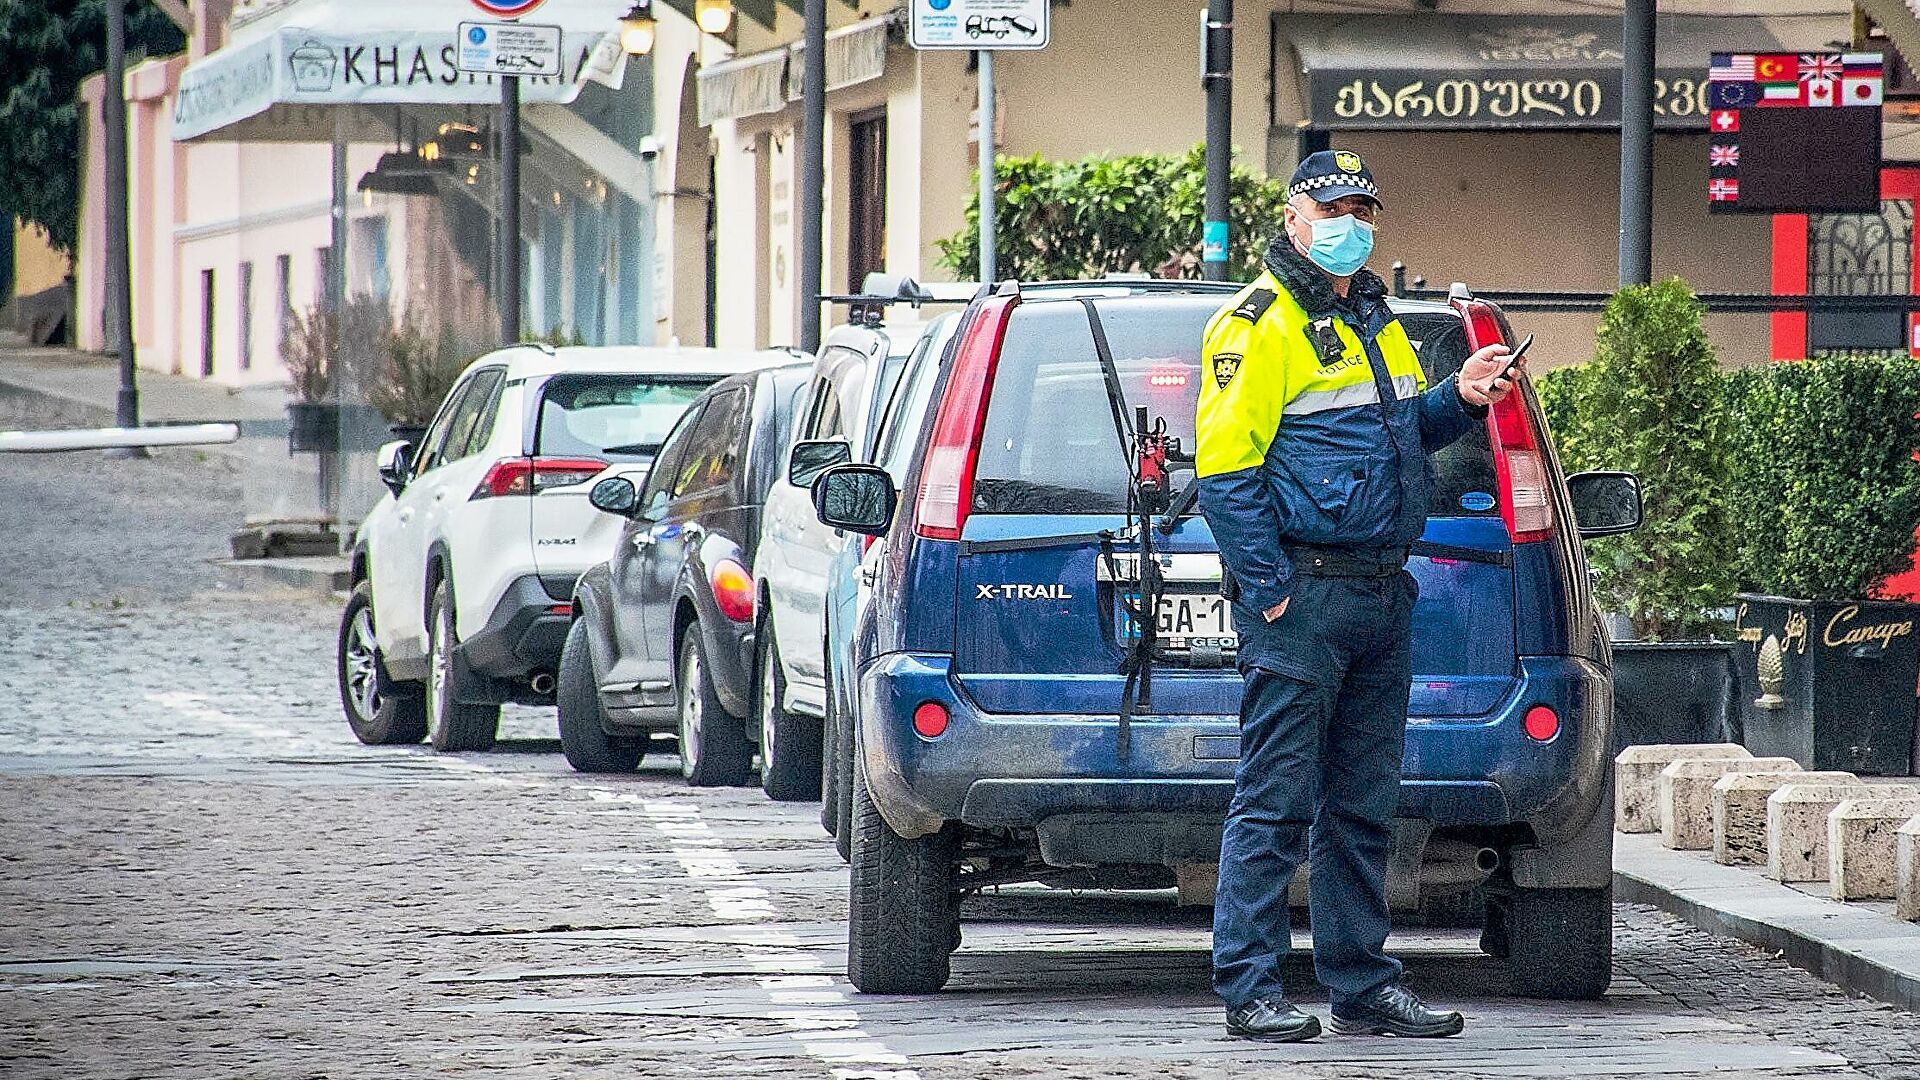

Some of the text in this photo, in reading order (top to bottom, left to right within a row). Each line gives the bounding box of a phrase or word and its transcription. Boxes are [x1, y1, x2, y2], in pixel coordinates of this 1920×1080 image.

[1334, 79, 1602, 118] ქართული
[975, 584, 1073, 599] X-TRAIL
[1824, 603, 1913, 650] Canape
